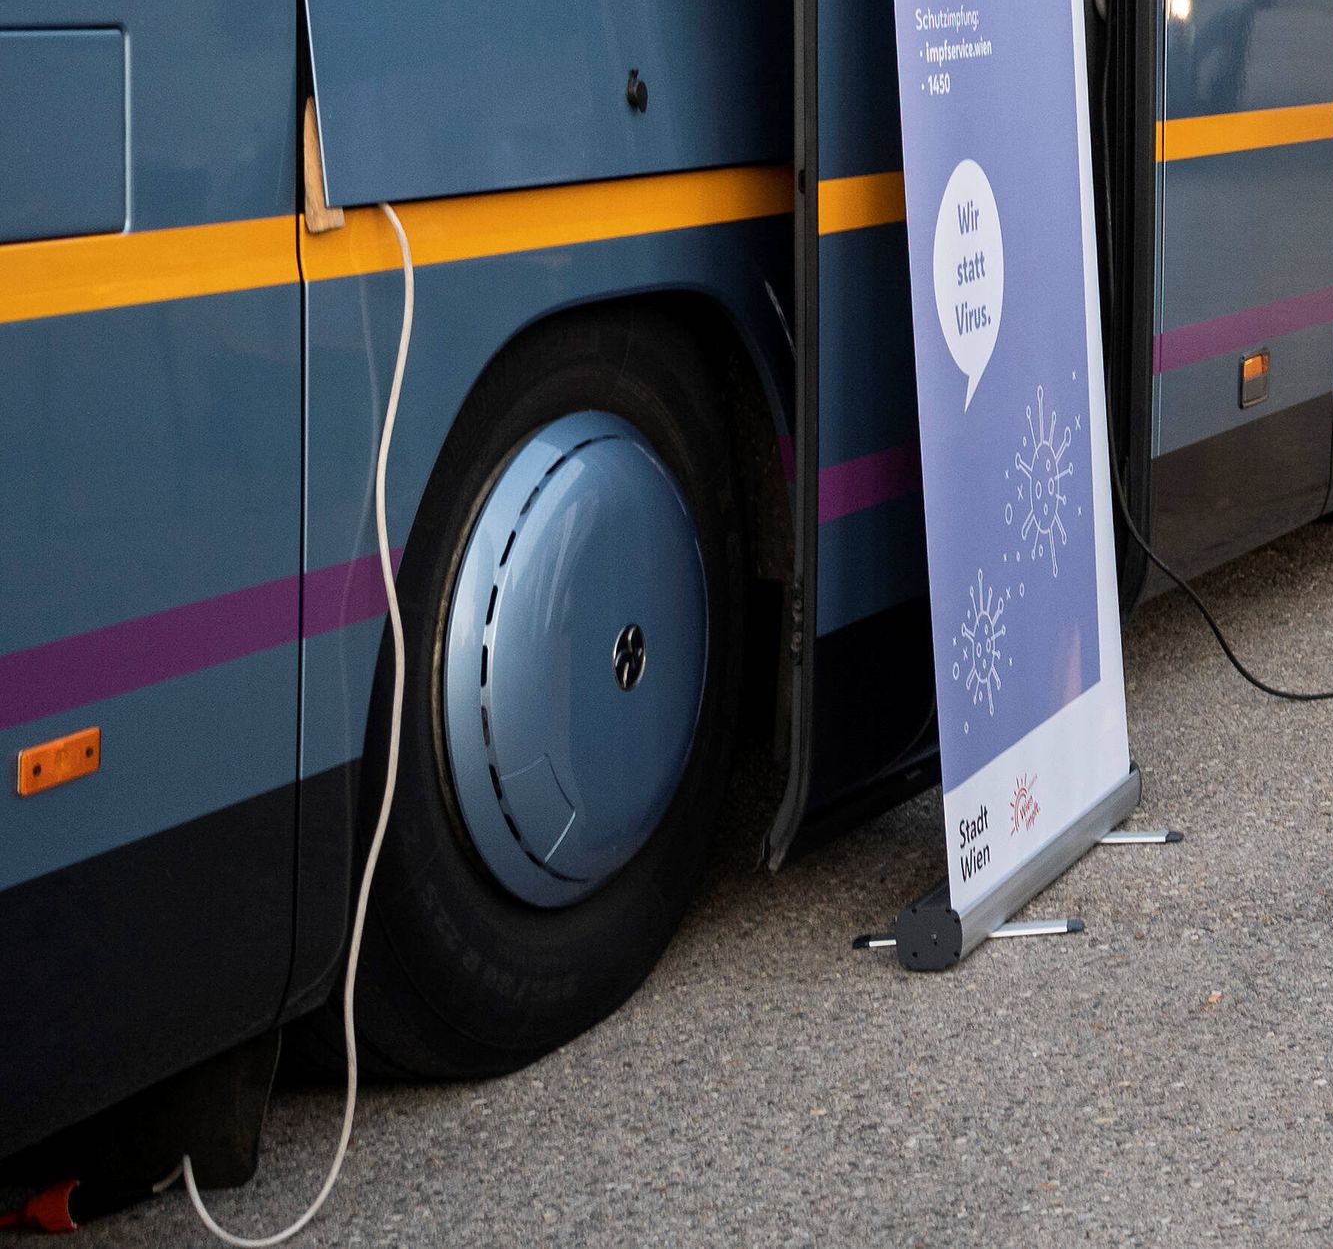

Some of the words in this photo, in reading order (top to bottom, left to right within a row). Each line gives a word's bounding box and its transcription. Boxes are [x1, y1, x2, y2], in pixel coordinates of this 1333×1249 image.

[915, 4, 980, 33] Schutzimpfung:
[926, 35, 992, 68] impfservice.wien
[927, 72, 951, 95] 1450
[957, 199, 980, 235] Wir
[957, 251, 986, 286] statt
[955, 301, 991, 336] Virus.
[959, 804, 989, 849] Stadt
[960, 844, 991, 883] Wien
